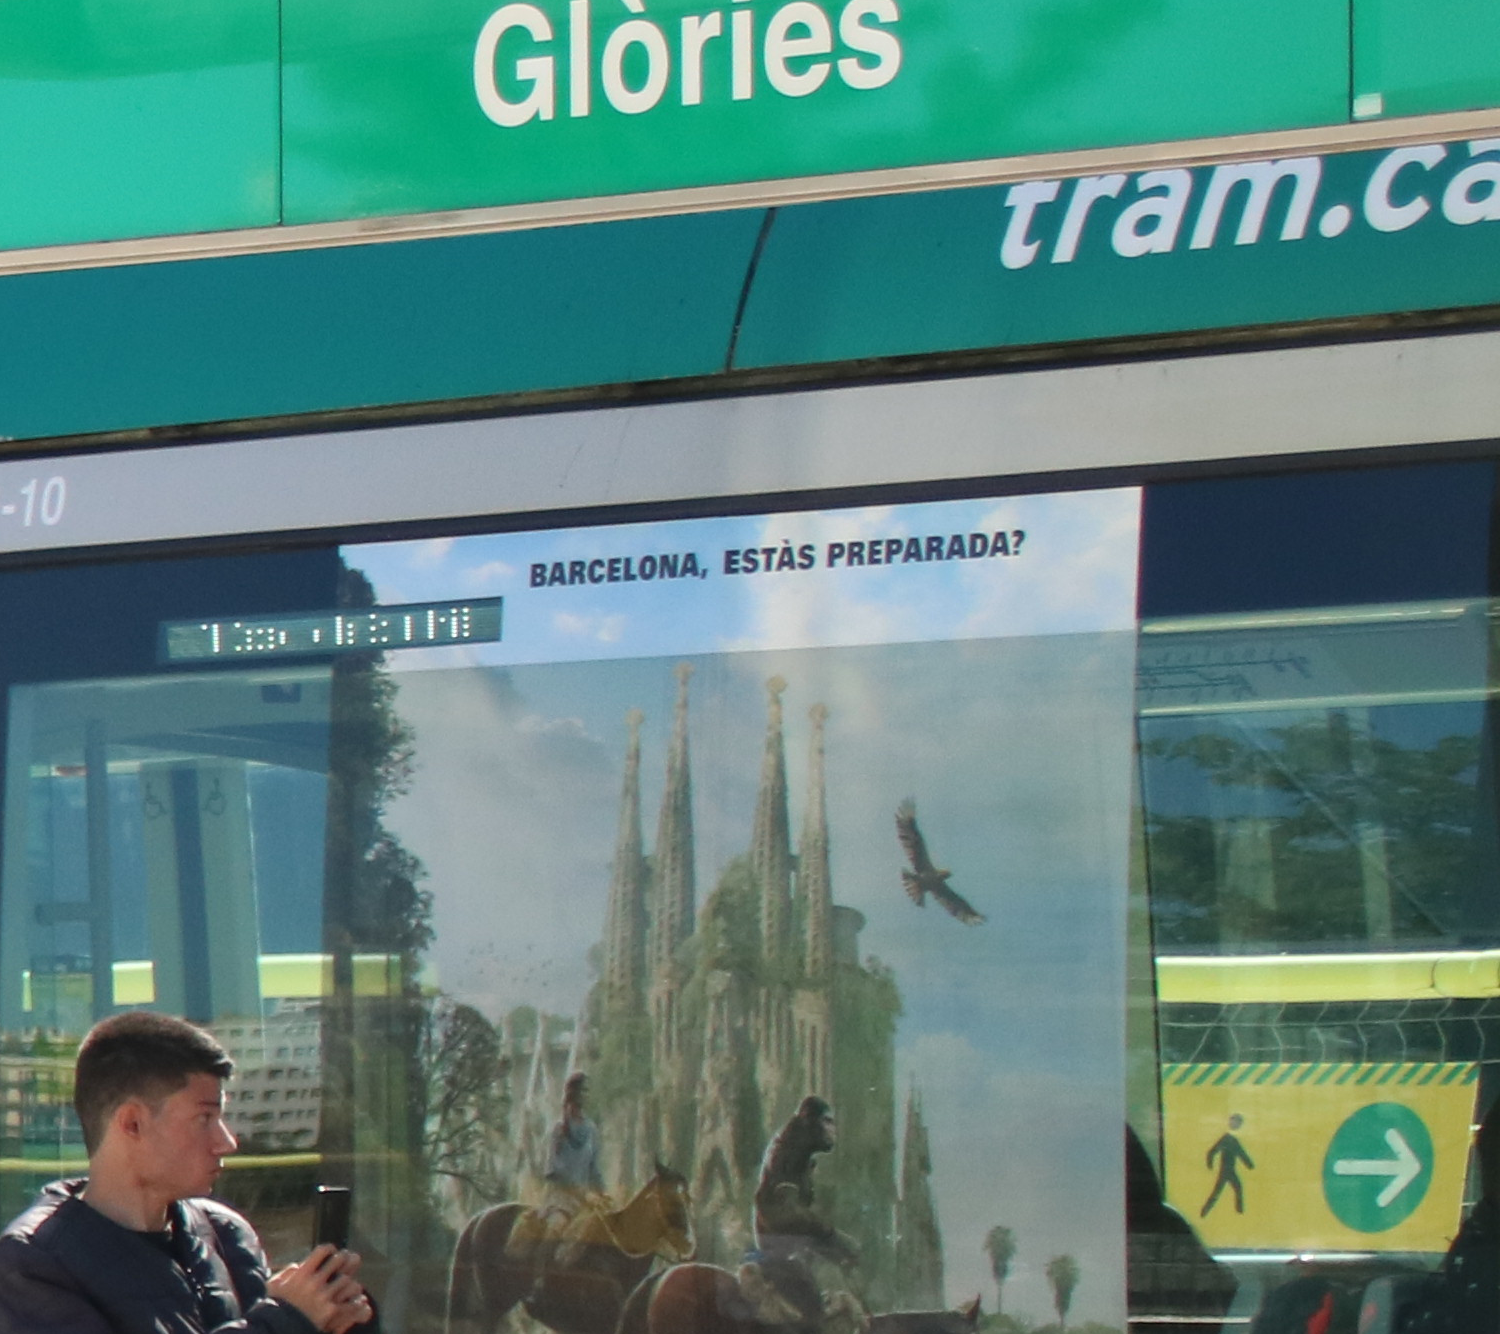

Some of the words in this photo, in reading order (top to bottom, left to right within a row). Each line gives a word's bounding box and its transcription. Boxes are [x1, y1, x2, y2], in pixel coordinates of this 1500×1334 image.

[529, 552, 708, 588] BARCELONA,
[723, 539, 815, 574] ESTÀS
[826, 530, 1027, 567] PREPARADA?
